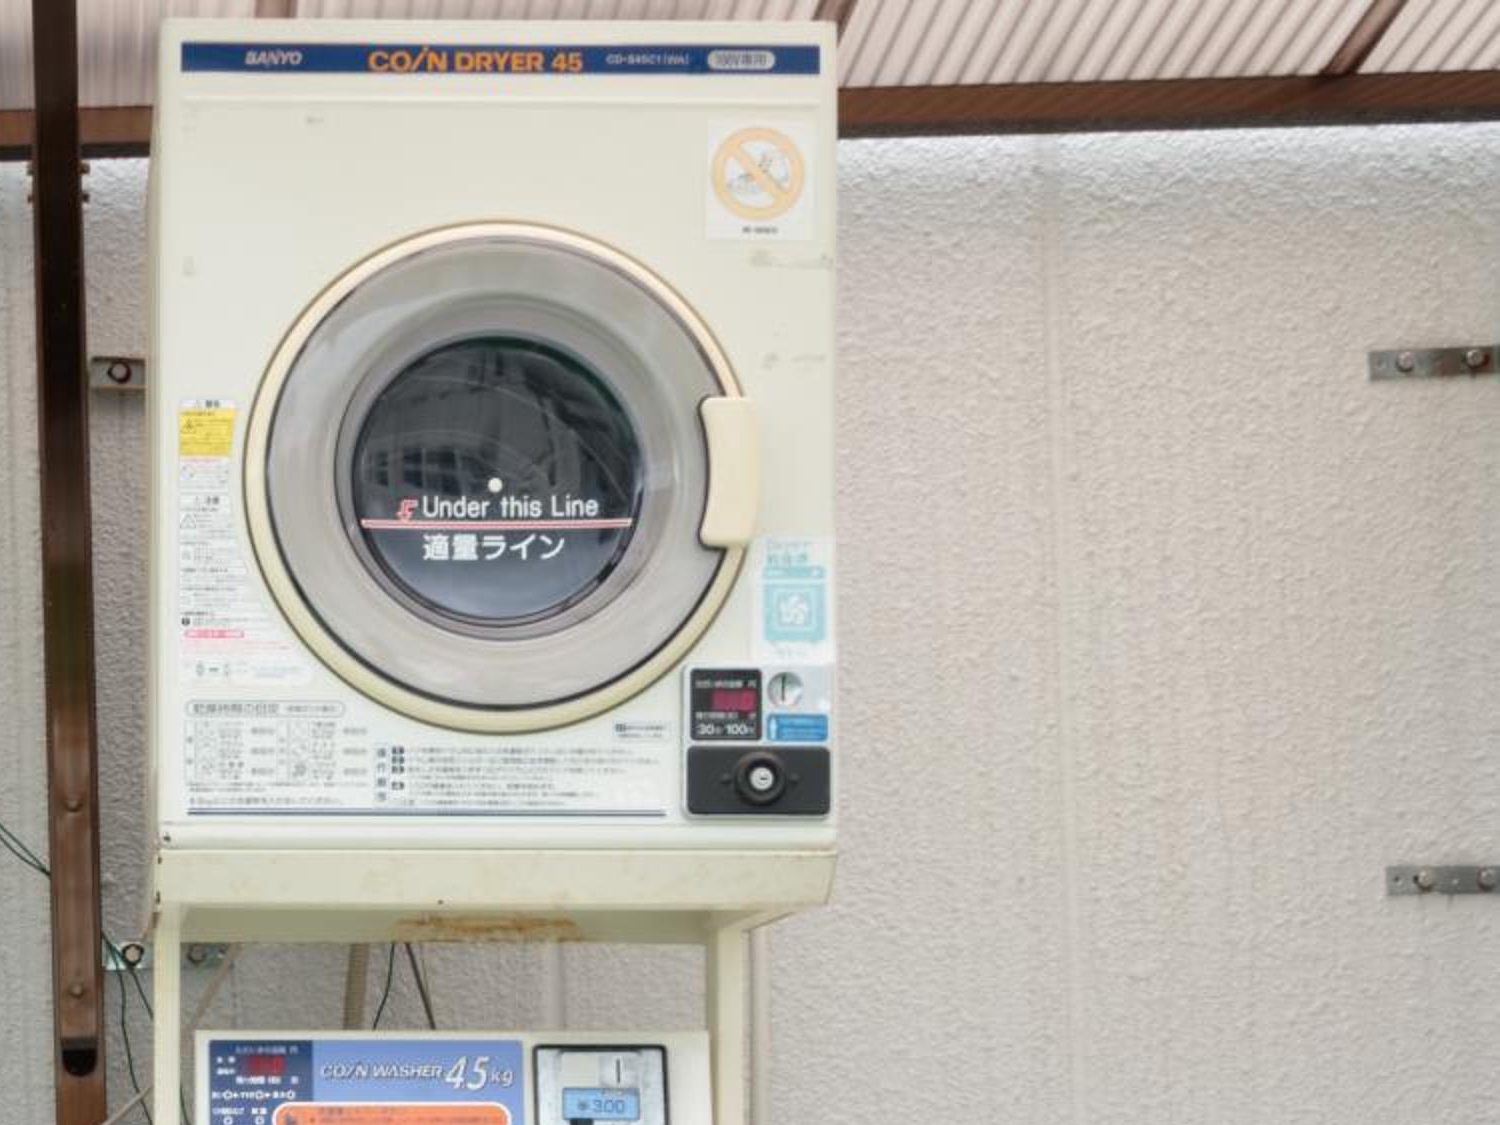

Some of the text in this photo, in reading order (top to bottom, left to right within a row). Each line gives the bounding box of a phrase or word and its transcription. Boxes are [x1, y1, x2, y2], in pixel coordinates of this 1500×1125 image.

[244, 48, 303, 66] SANYO
[454, 50, 544, 73] DRYER
[551, 52, 583, 73] 45
[422, 494, 599, 518] Under this Line
[422, 533, 565, 561] 適量ライン
[372, 1064, 443, 1078] WASHER
